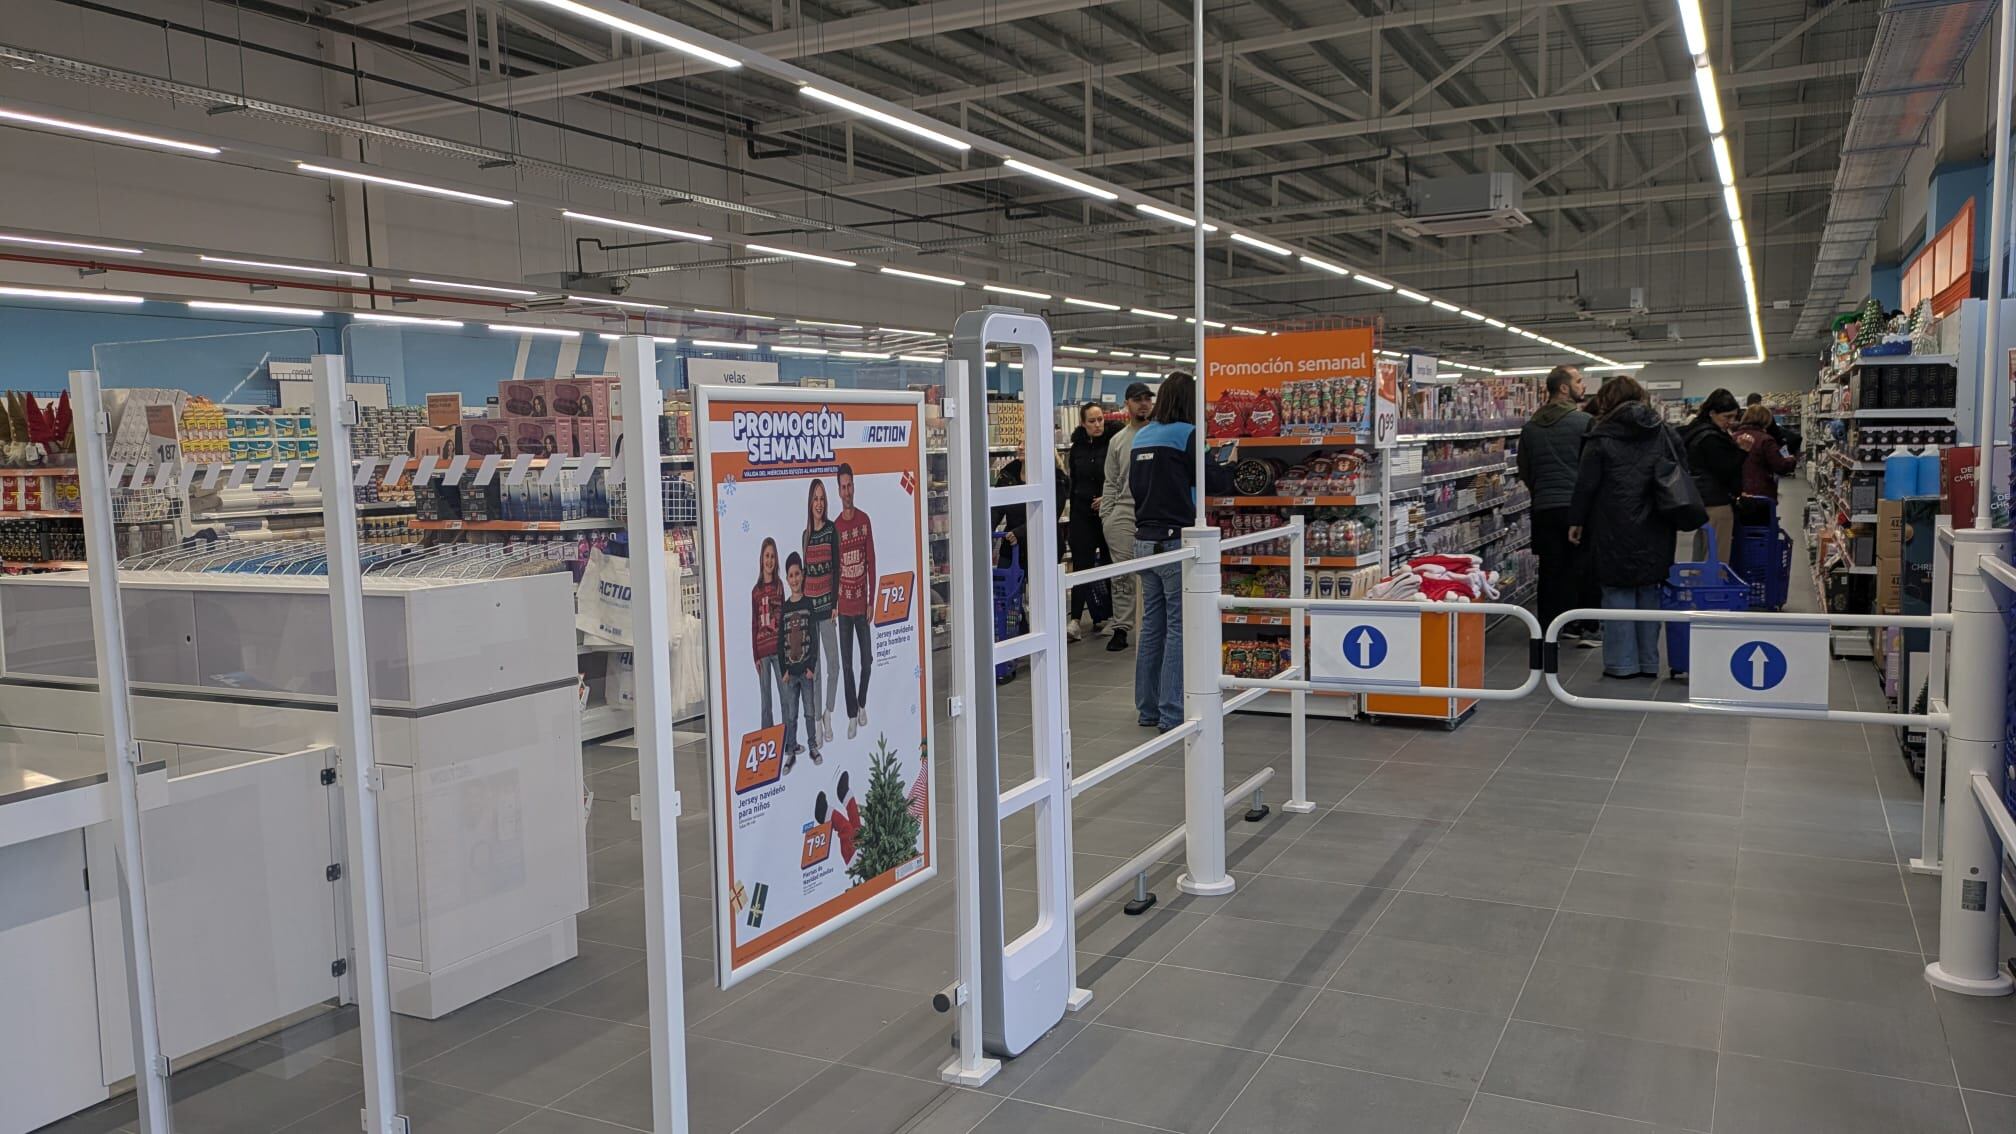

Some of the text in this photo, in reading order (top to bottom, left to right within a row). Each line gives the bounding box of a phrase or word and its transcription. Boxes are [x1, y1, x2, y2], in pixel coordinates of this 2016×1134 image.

[1209, 353, 1366, 377] Promoción semanal
[723, 370, 747, 384] velas
[733, 404, 844, 440] PROMOCIÓN
[867, 425, 906, 443] ACTION
[747, 435, 835, 464] SEMANAL
[599, 580, 632, 601] ACTIO
[876, 631, 891, 640] Jersey
[876, 640, 888, 650] para
[876, 648, 891, 658] mujer
[738, 785, 786, 808] Jersey navideño
[738, 807, 753, 820] para
[753, 800, 771, 813] niños
